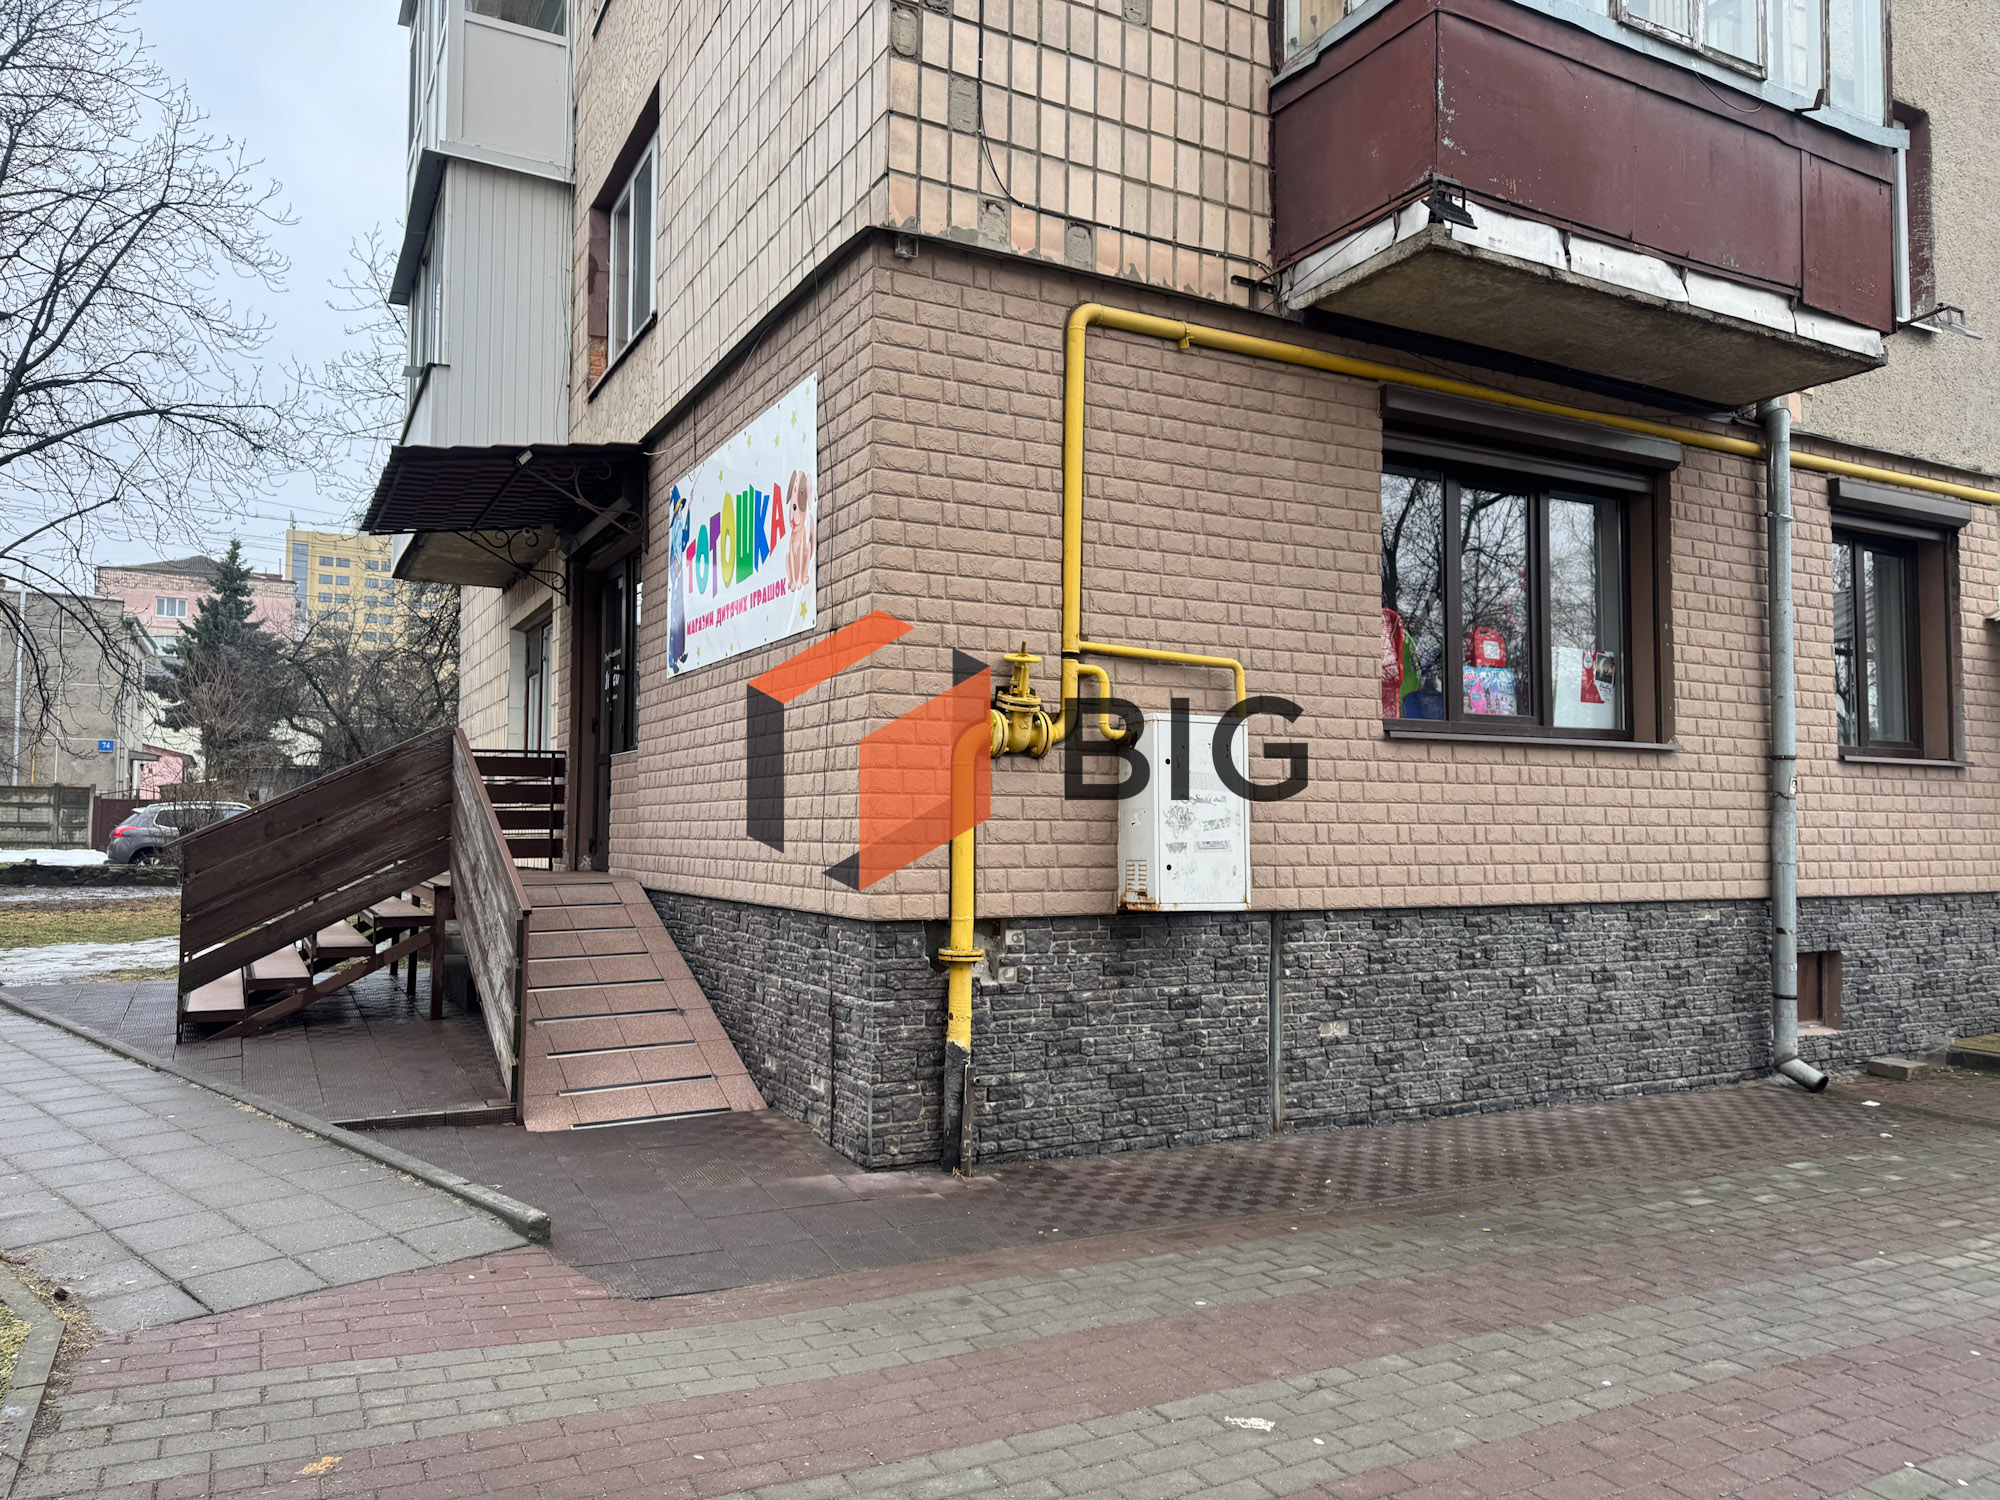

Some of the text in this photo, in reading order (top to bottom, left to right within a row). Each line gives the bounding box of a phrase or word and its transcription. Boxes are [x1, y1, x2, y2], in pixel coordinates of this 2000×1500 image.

[686, 482, 786, 598] ТОТОШКА
[687, 578, 787, 636] МАГАЗИН ДИТЯЧИХ ІГРАШОК
[101, 741, 110, 749] 74
